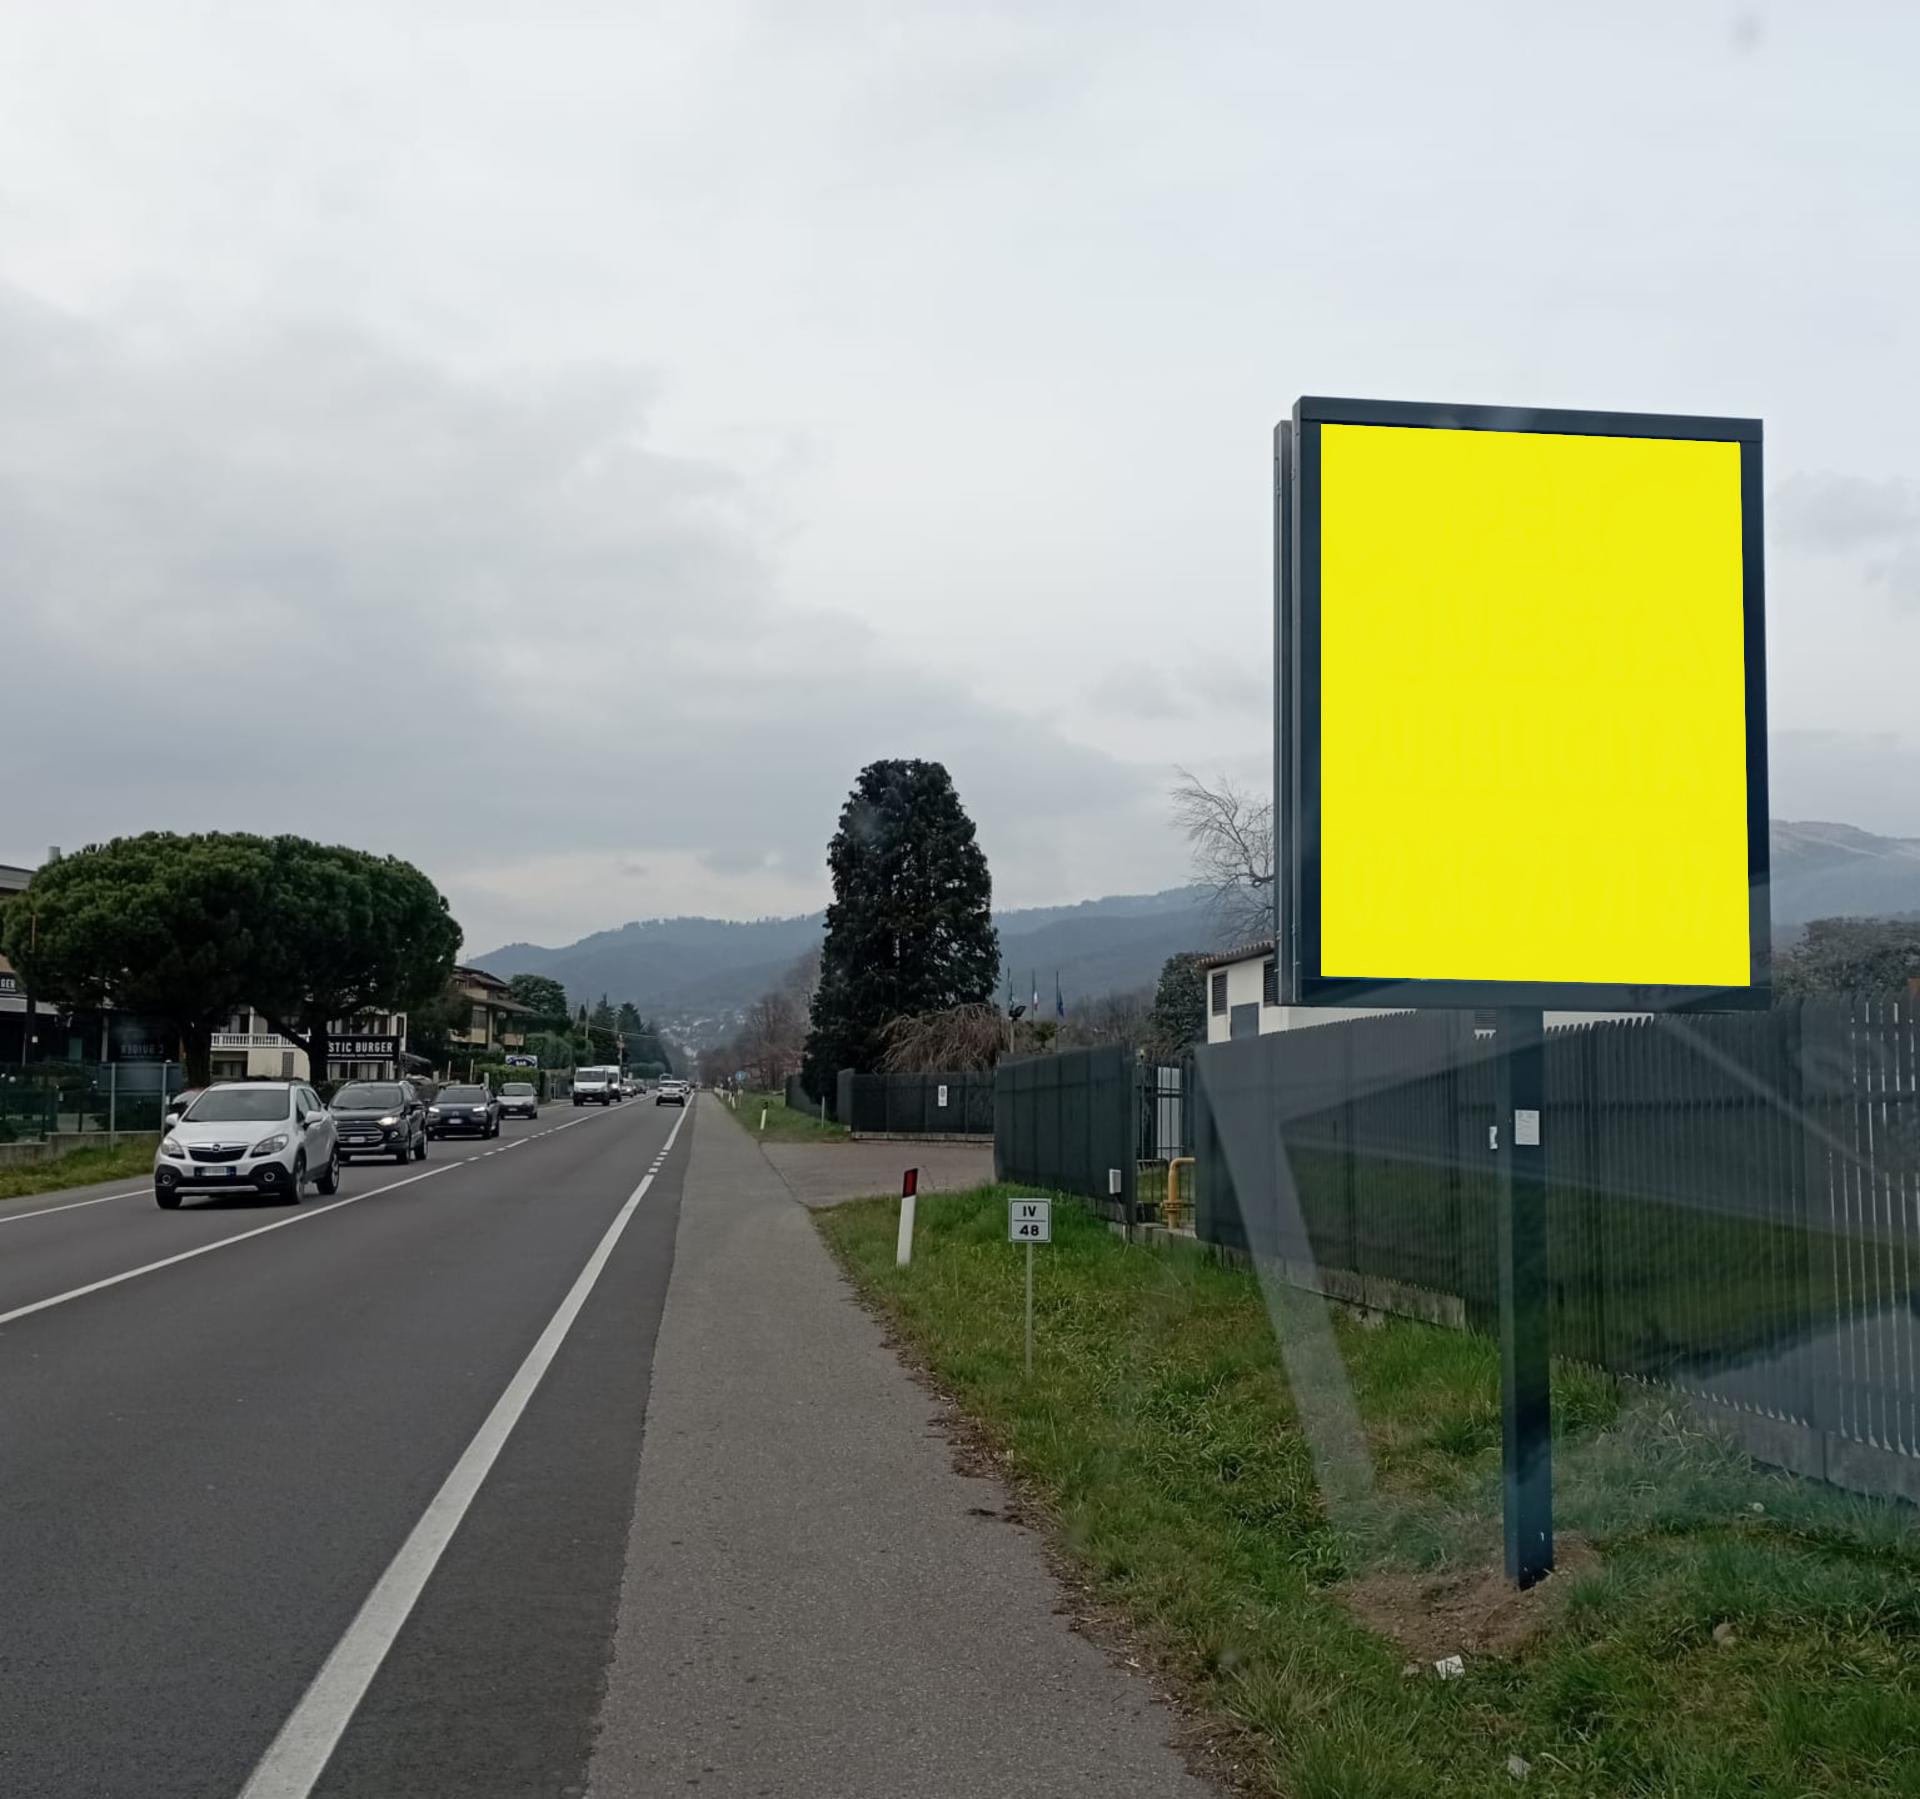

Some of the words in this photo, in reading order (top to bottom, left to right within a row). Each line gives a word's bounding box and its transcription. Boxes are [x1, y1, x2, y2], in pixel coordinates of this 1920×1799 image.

[327, 1041, 352, 1053] STIC
[355, 1041, 393, 1053] BURGER
[1022, 1205, 1037, 1217] IV
[1019, 1224, 1040, 1236] 48
